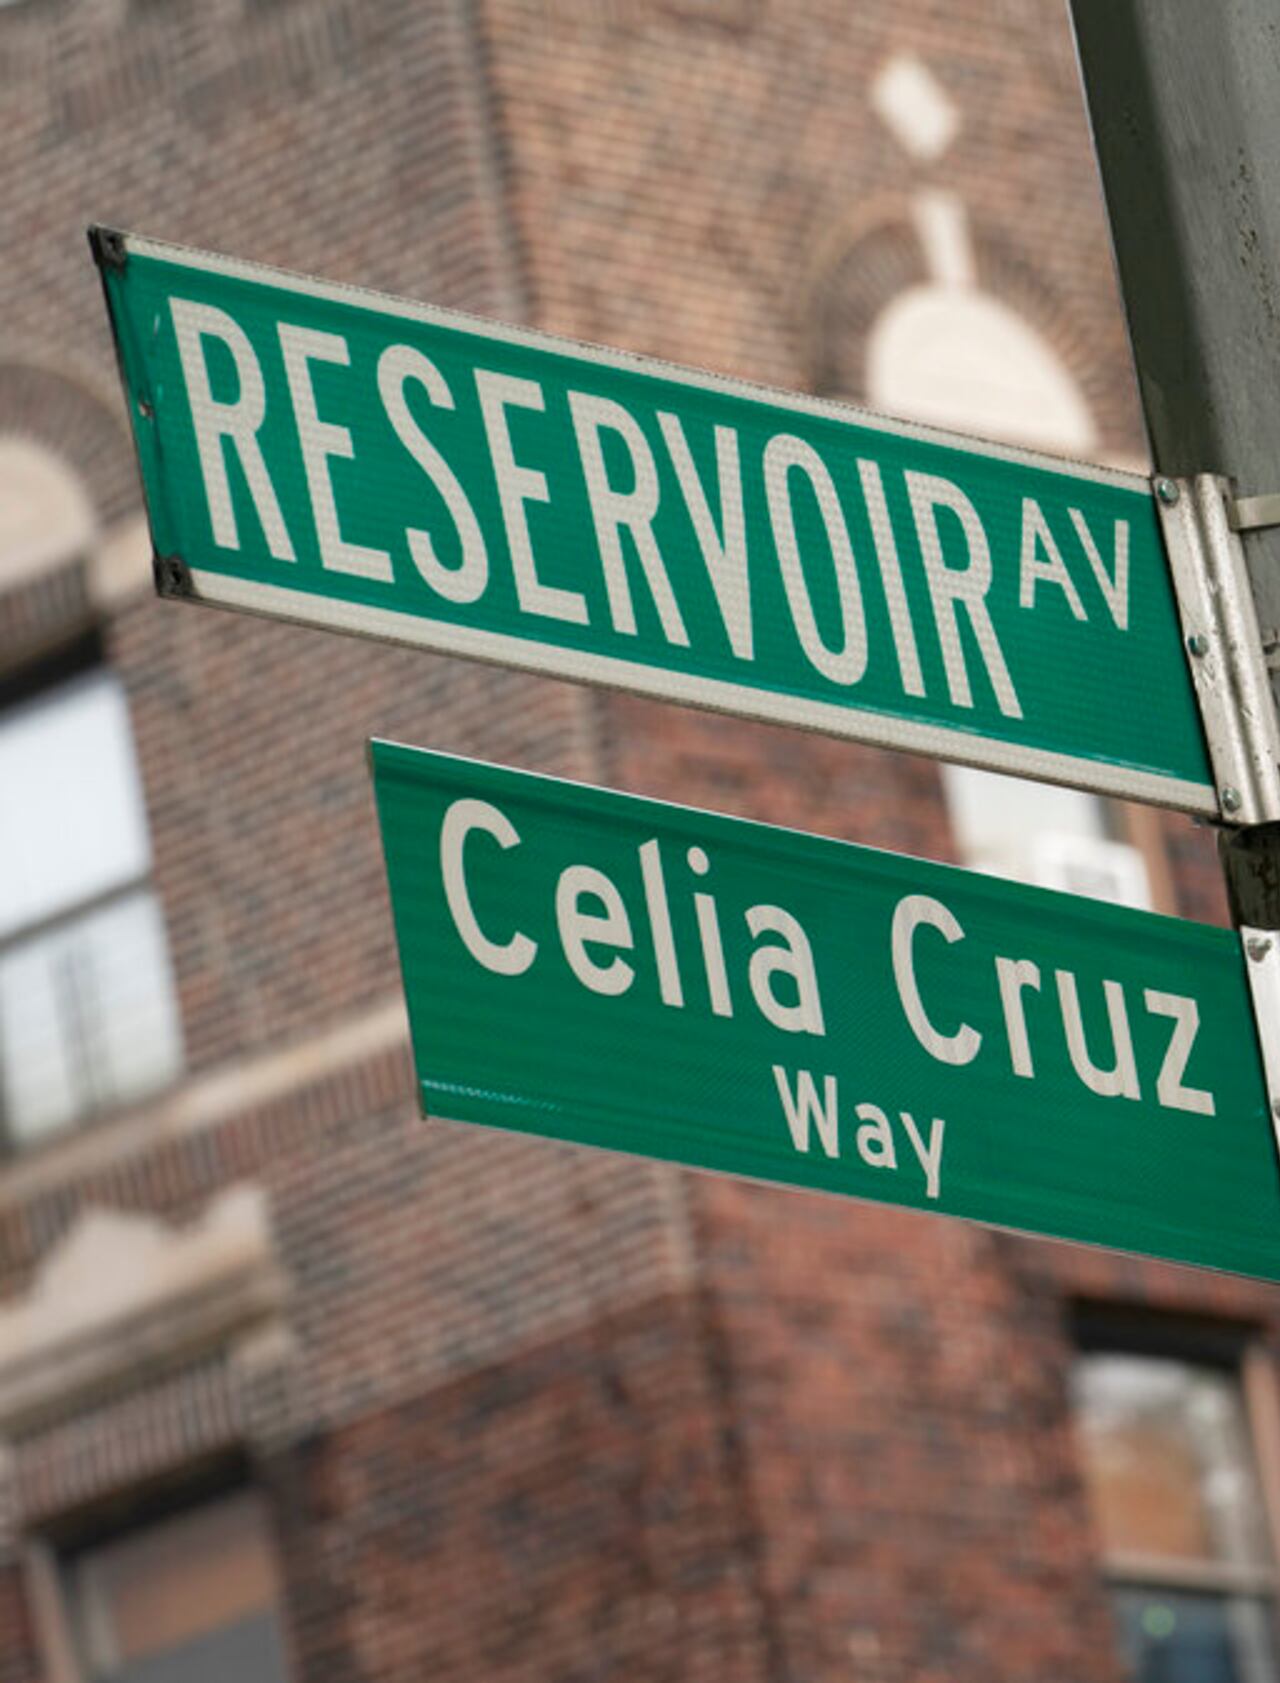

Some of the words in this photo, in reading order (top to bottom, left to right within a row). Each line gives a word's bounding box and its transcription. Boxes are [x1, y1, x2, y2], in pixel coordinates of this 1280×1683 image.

[168, 296, 1023, 719] RESERVOIR
[1018, 497, 1131, 631] AV
[440, 798, 825, 1036] Celia
[891, 893, 1216, 1117] Cruz
[772, 1064, 945, 1198] Way
